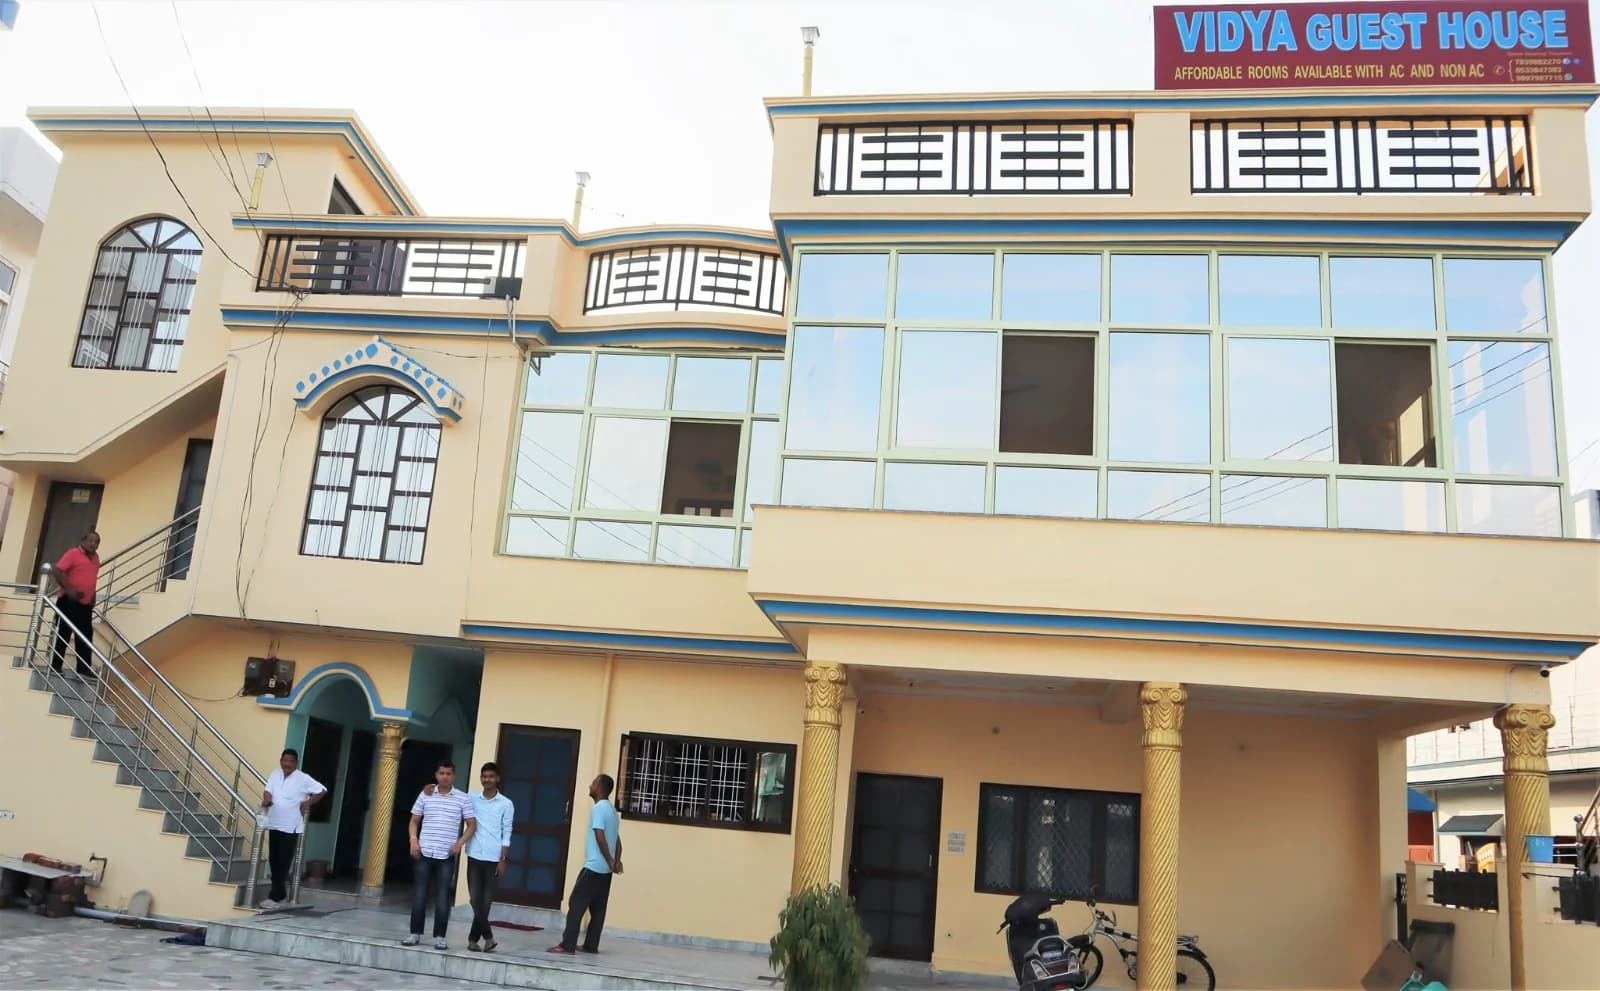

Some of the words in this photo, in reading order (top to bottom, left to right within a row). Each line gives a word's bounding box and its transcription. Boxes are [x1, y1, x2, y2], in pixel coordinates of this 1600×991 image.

[1174, 9, 1298, 53] VIDYA
[1305, 12, 1428, 51] GUEST
[1438, 10, 1569, 50] HOUSE
[1174, 66, 1243, 80] AFFORDABLE
[1248, 65, 1289, 79] ROOMS
[1294, 65, 1352, 79] AVAILABLE
[1354, 64, 1384, 79] WITH
[1389, 65, 1405, 78] AC
[1410, 64, 1435, 78] AND
[1440, 64, 1467, 78] NON
[1469, 64, 1485, 78] AC
